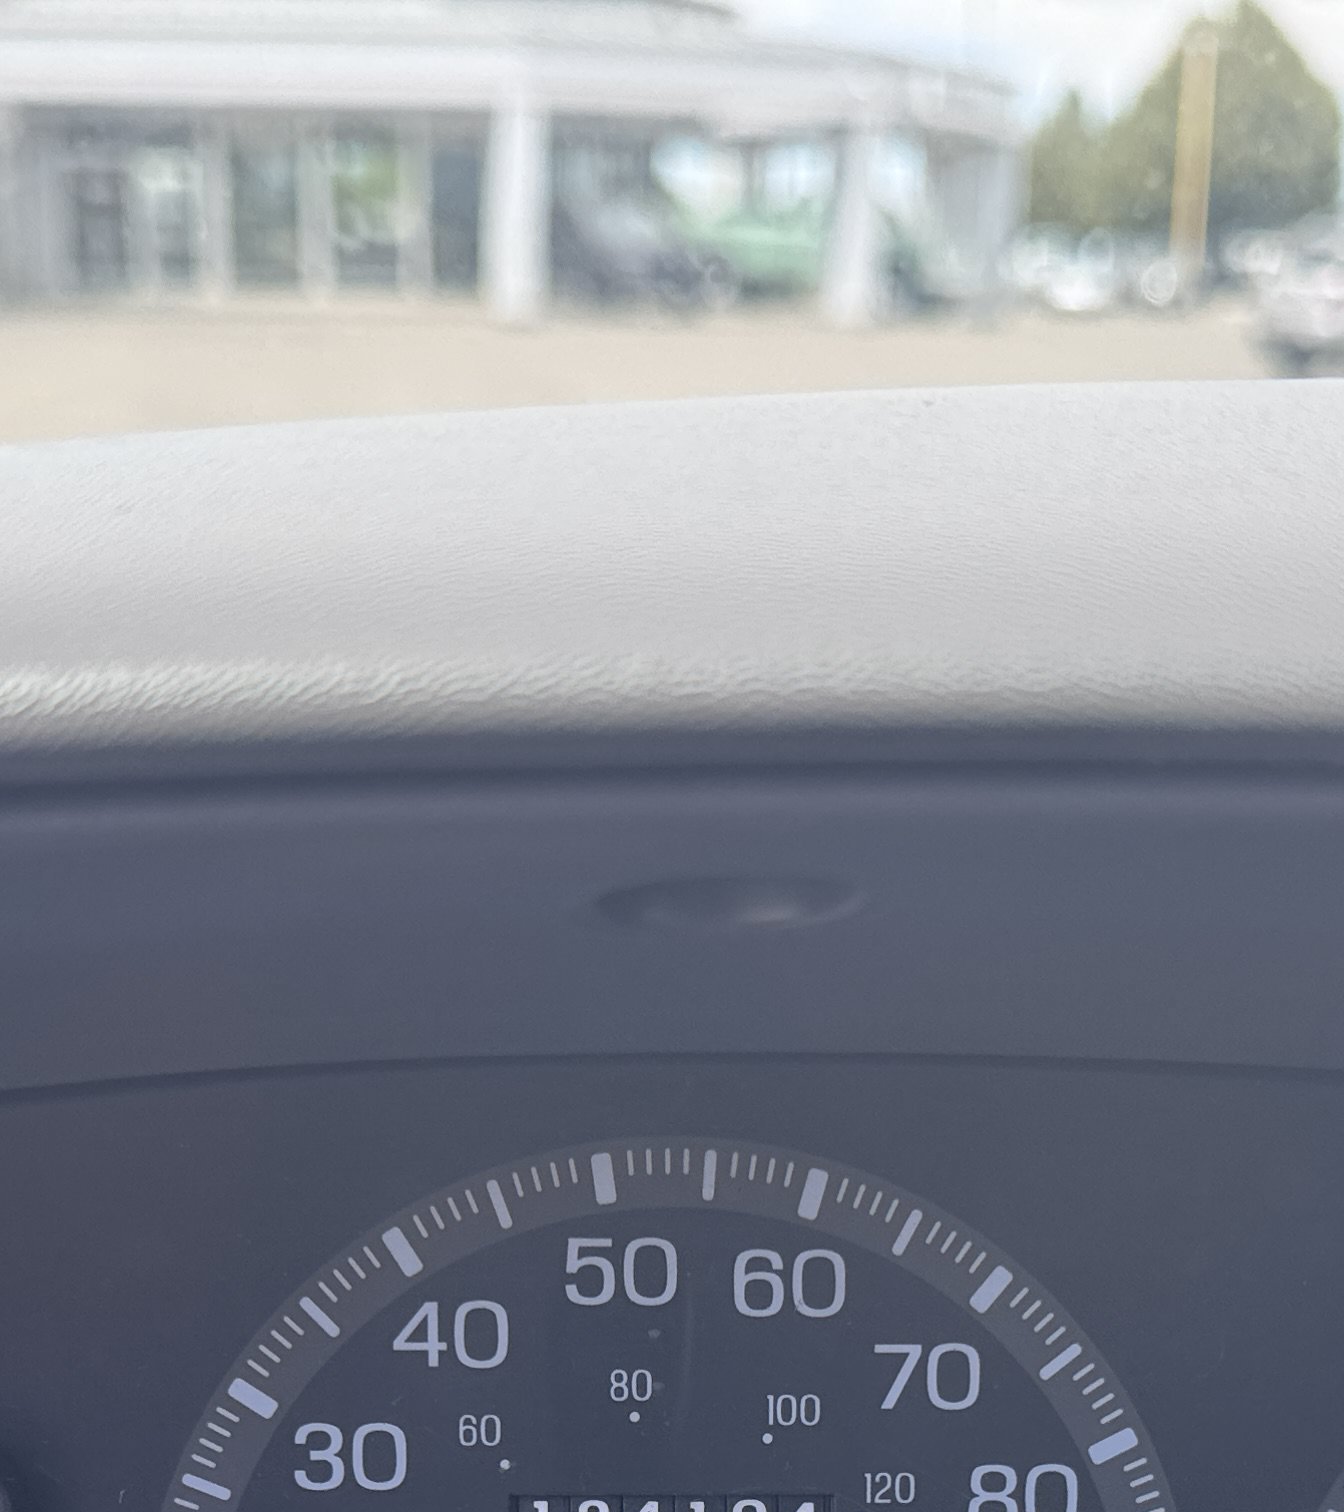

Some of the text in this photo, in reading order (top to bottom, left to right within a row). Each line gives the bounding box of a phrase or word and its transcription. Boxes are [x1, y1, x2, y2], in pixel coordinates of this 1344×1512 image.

[565, 1237, 678, 1306] 50
[733, 1248, 846, 1318] 60
[392, 1300, 509, 1369] 40
[610, 1369, 653, 1402] 80
[767, 1394, 821, 1426] 100
[874, 1342, 981, 1410] 70
[294, 1422, 407, 1491] 30
[458, 1414, 501, 1447] 60
[864, 1472, 916, 1504] 120
